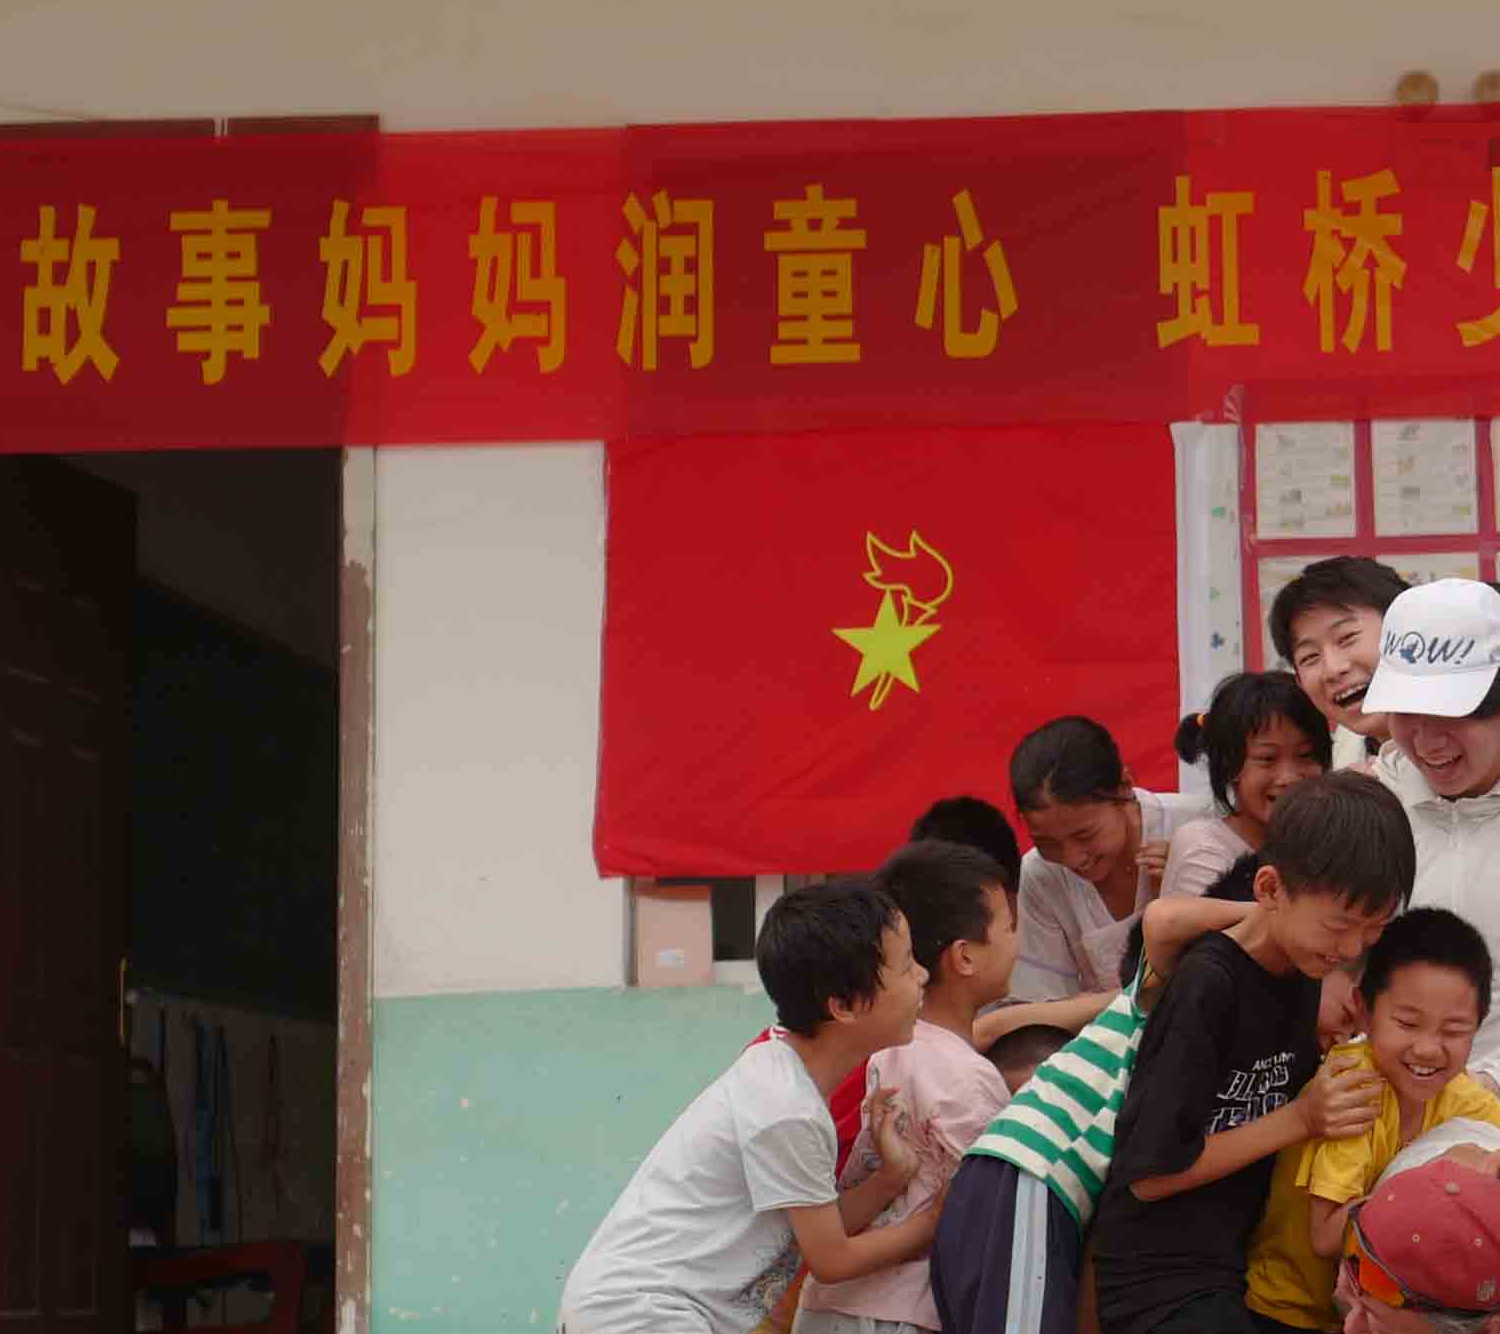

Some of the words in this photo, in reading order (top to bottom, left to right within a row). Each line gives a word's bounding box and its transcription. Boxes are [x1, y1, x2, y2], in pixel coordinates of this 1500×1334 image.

[19, 183, 1020, 386] 故事妈妈润童心
